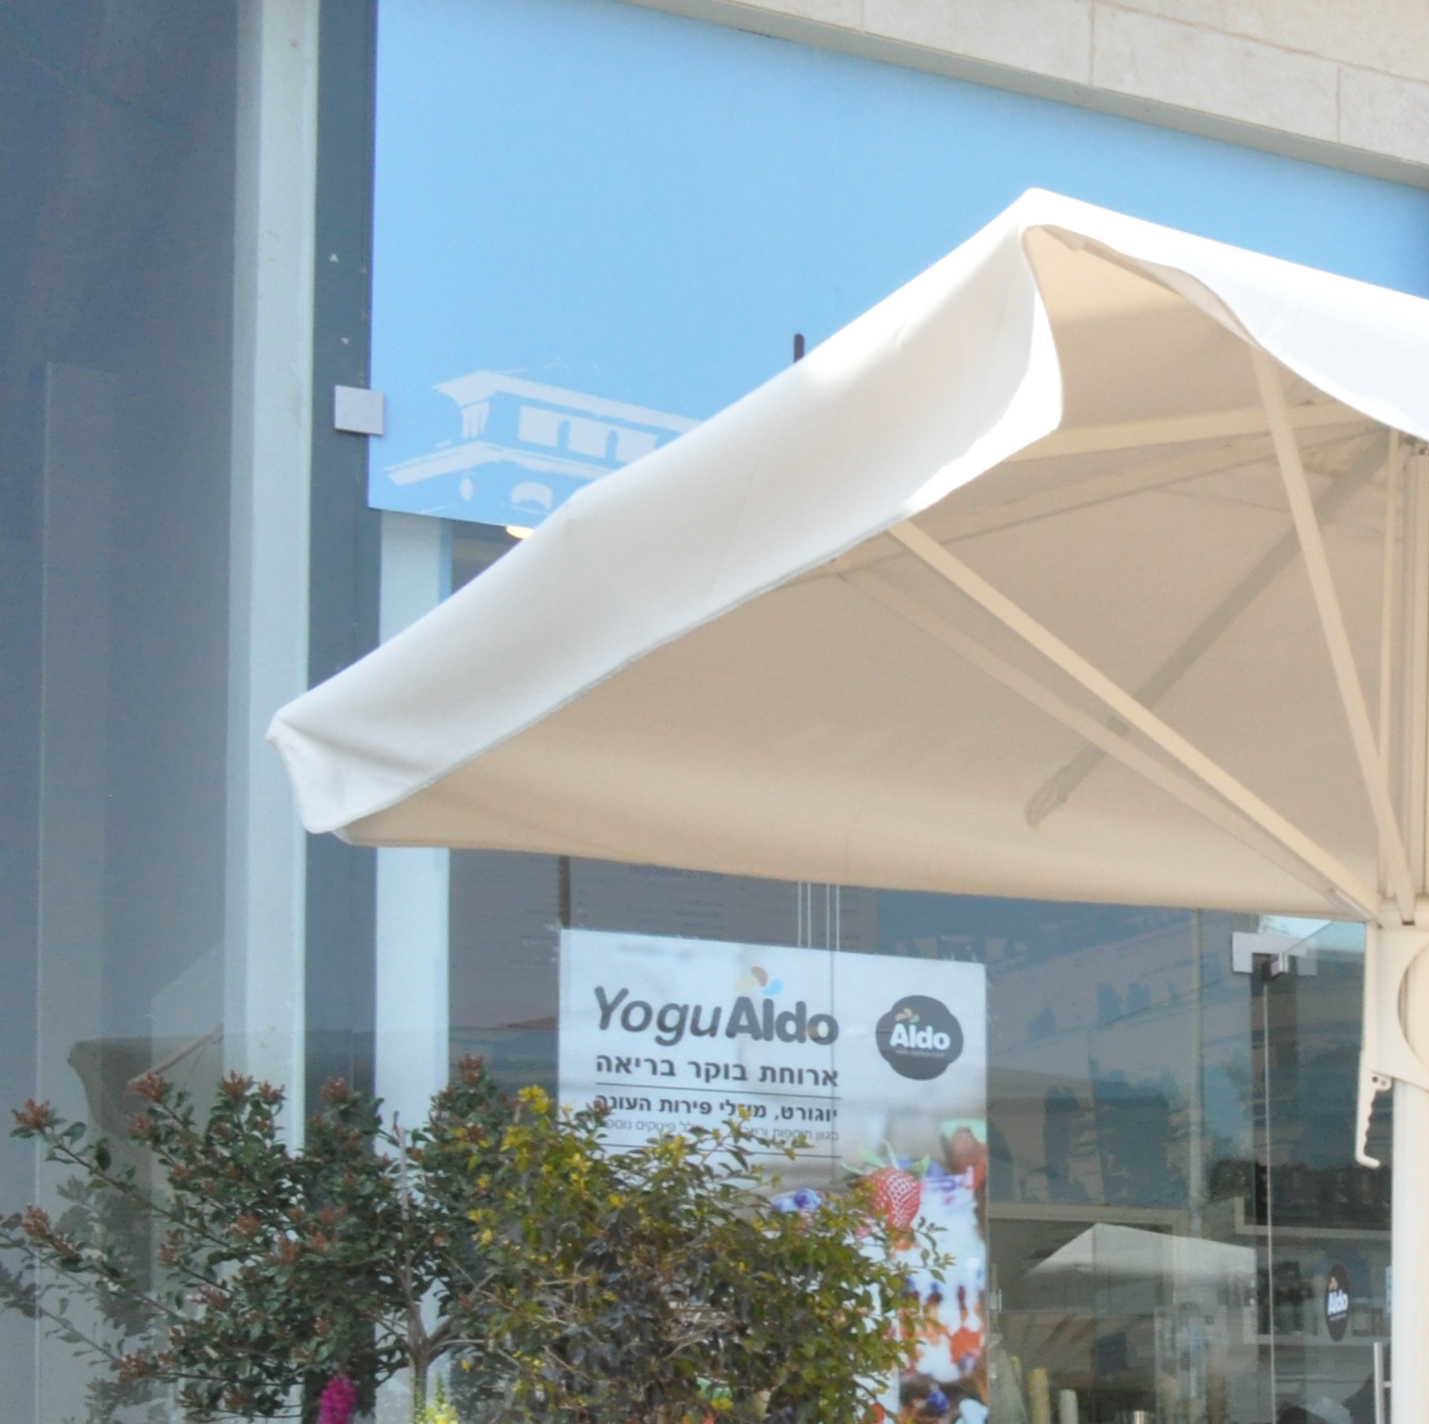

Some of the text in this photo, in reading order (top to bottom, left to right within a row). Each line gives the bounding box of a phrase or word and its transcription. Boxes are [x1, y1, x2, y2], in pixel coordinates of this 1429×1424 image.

[889, 1022, 951, 1051] Aldo
[596, 1055, 838, 1088] ארוחת בוקר בריאה
[659, 1099, 712, 1115] פירות
[774, 1105, 838, 1122] יוגורט,
